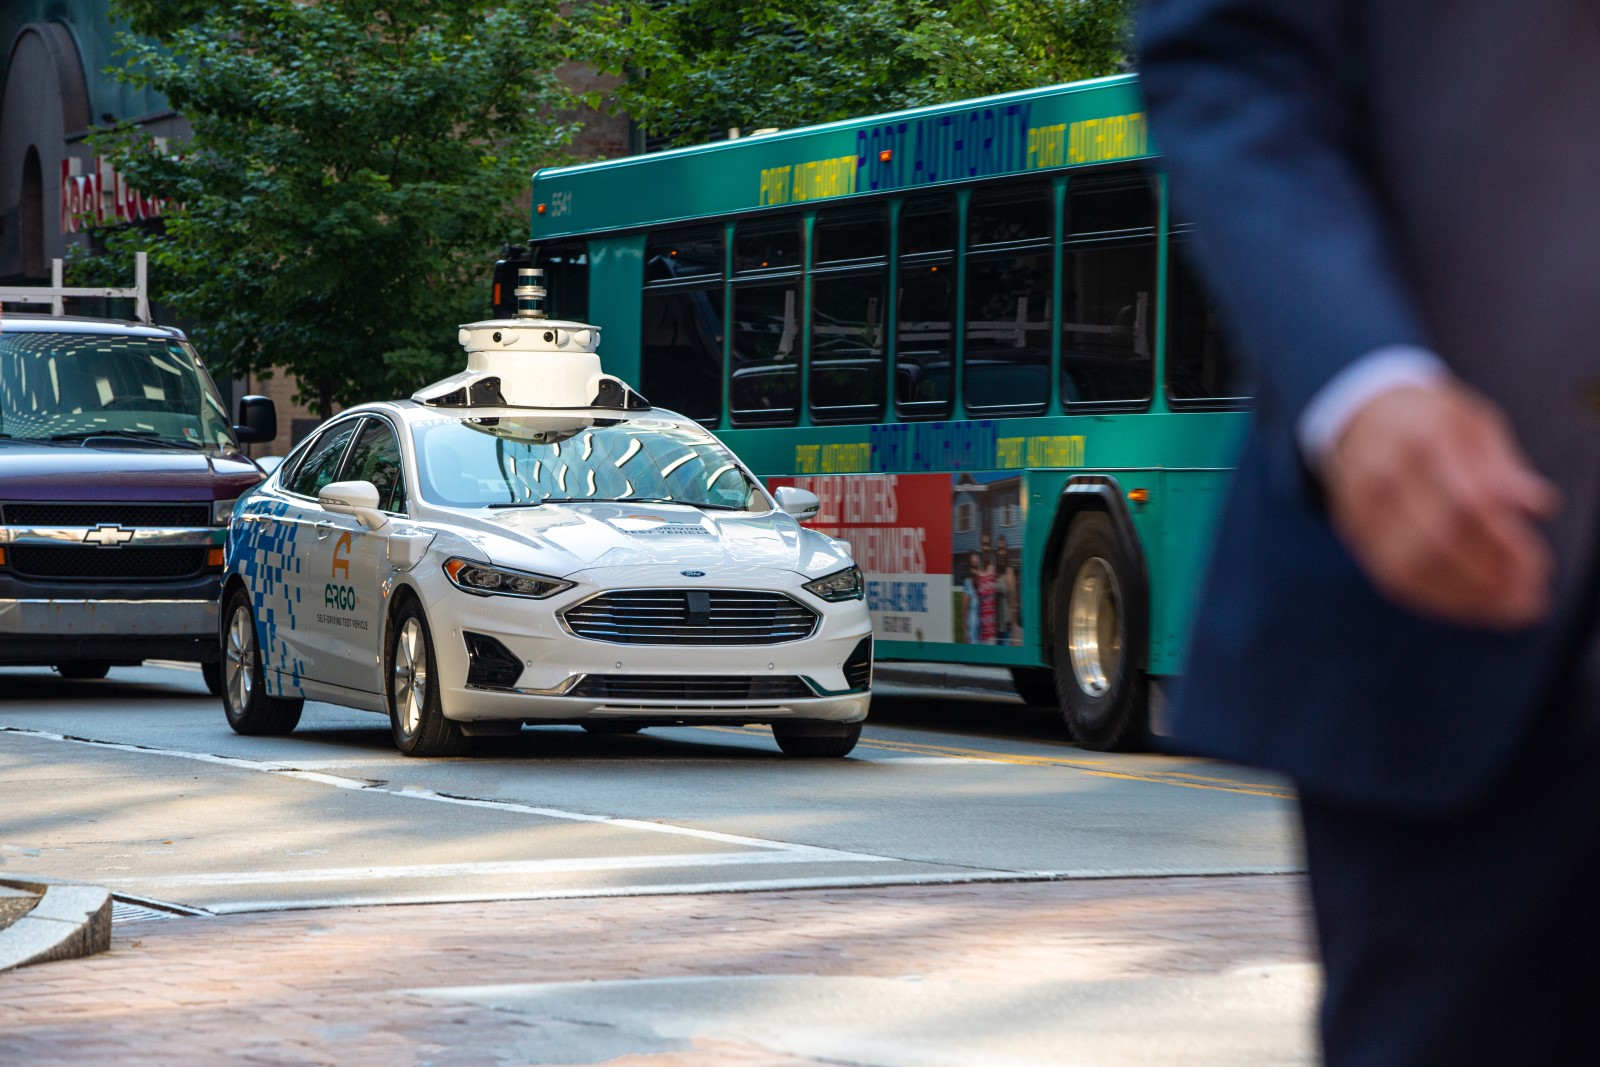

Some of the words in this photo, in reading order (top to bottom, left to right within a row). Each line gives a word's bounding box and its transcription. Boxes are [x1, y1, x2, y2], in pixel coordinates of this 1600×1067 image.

[856, 123, 909, 192] PORT
[911, 103, 1032, 186] AUTHORITY
[324, 583, 356, 612] ARGO
